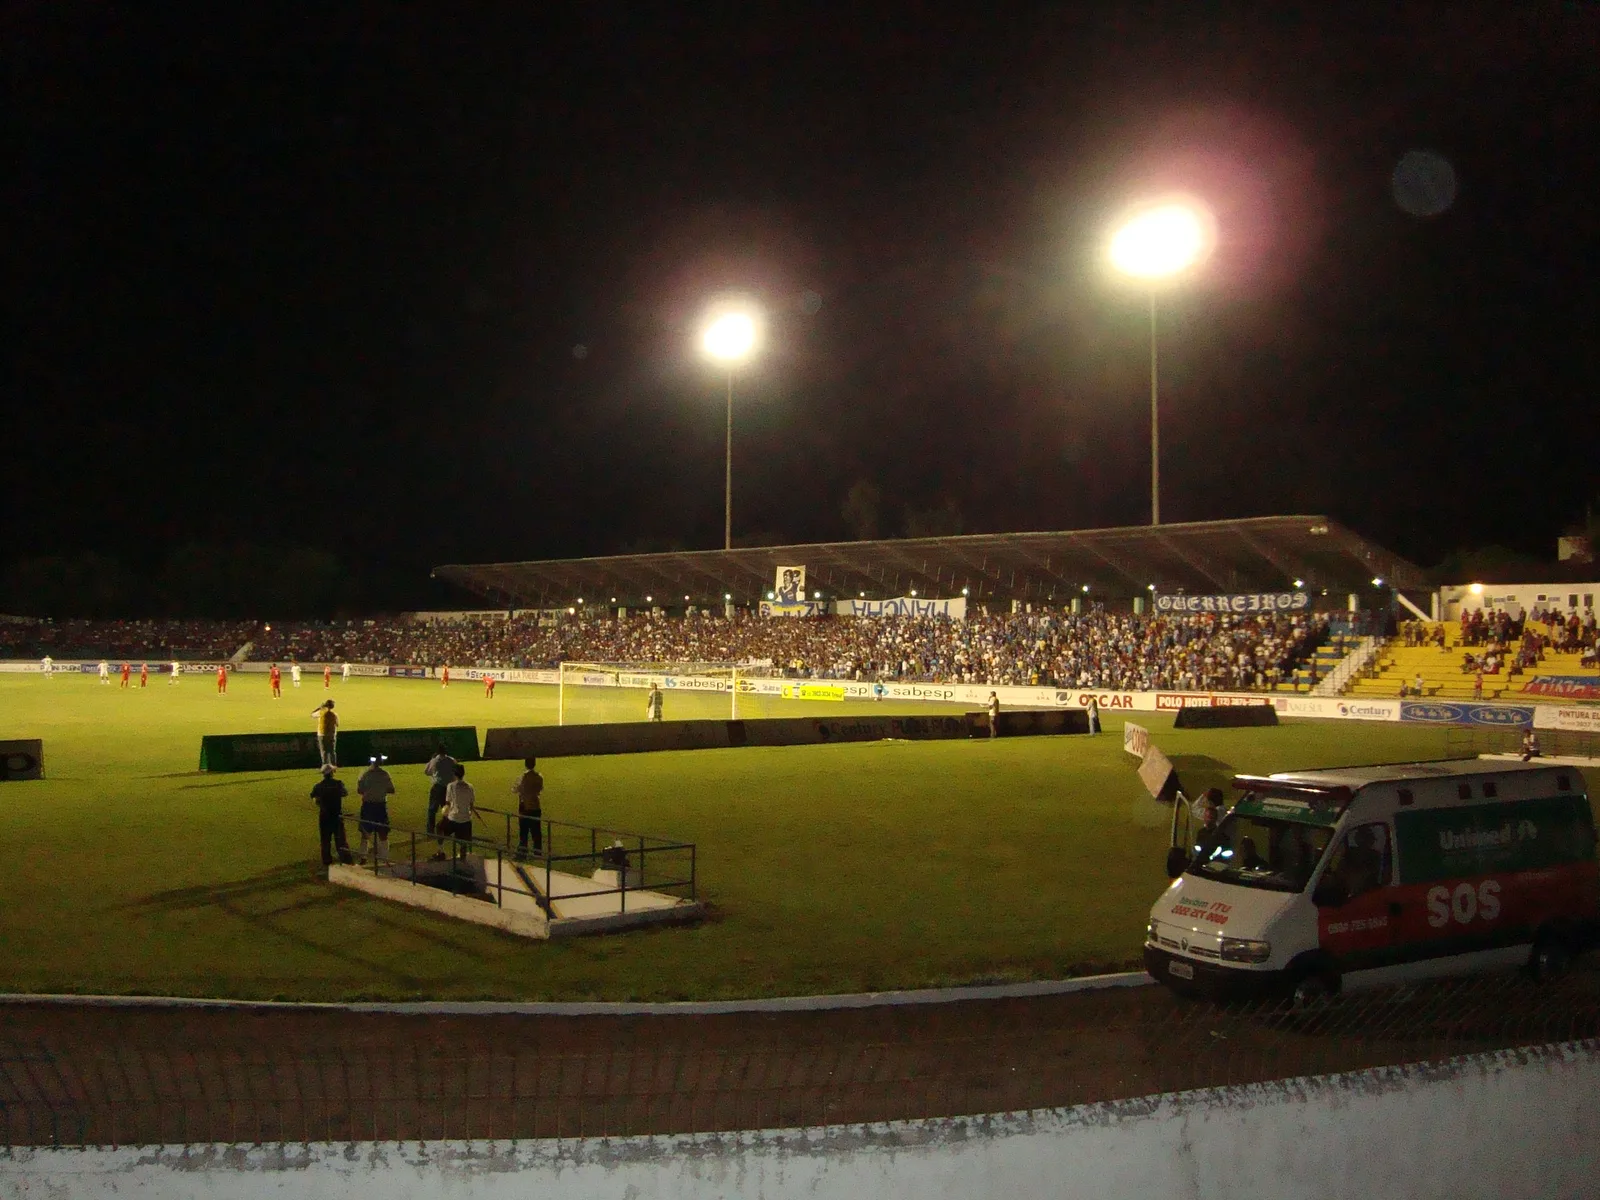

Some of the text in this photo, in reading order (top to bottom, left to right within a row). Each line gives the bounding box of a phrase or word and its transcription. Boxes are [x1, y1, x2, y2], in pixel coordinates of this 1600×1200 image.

[1157, 591, 1308, 612] GUERREIROS
[679, 678, 724, 690] sabesp
[893, 684, 954, 699] sabesp
[1079, 693, 1133, 708] OCAR
[1158, 696, 1182, 708] POLO
[1184, 697, 1212, 708] HOTEL
[1350, 705, 1393, 717] Century
[1558, 710, 1590, 719] PINTURA
[1427, 879, 1502, 928] SOS
